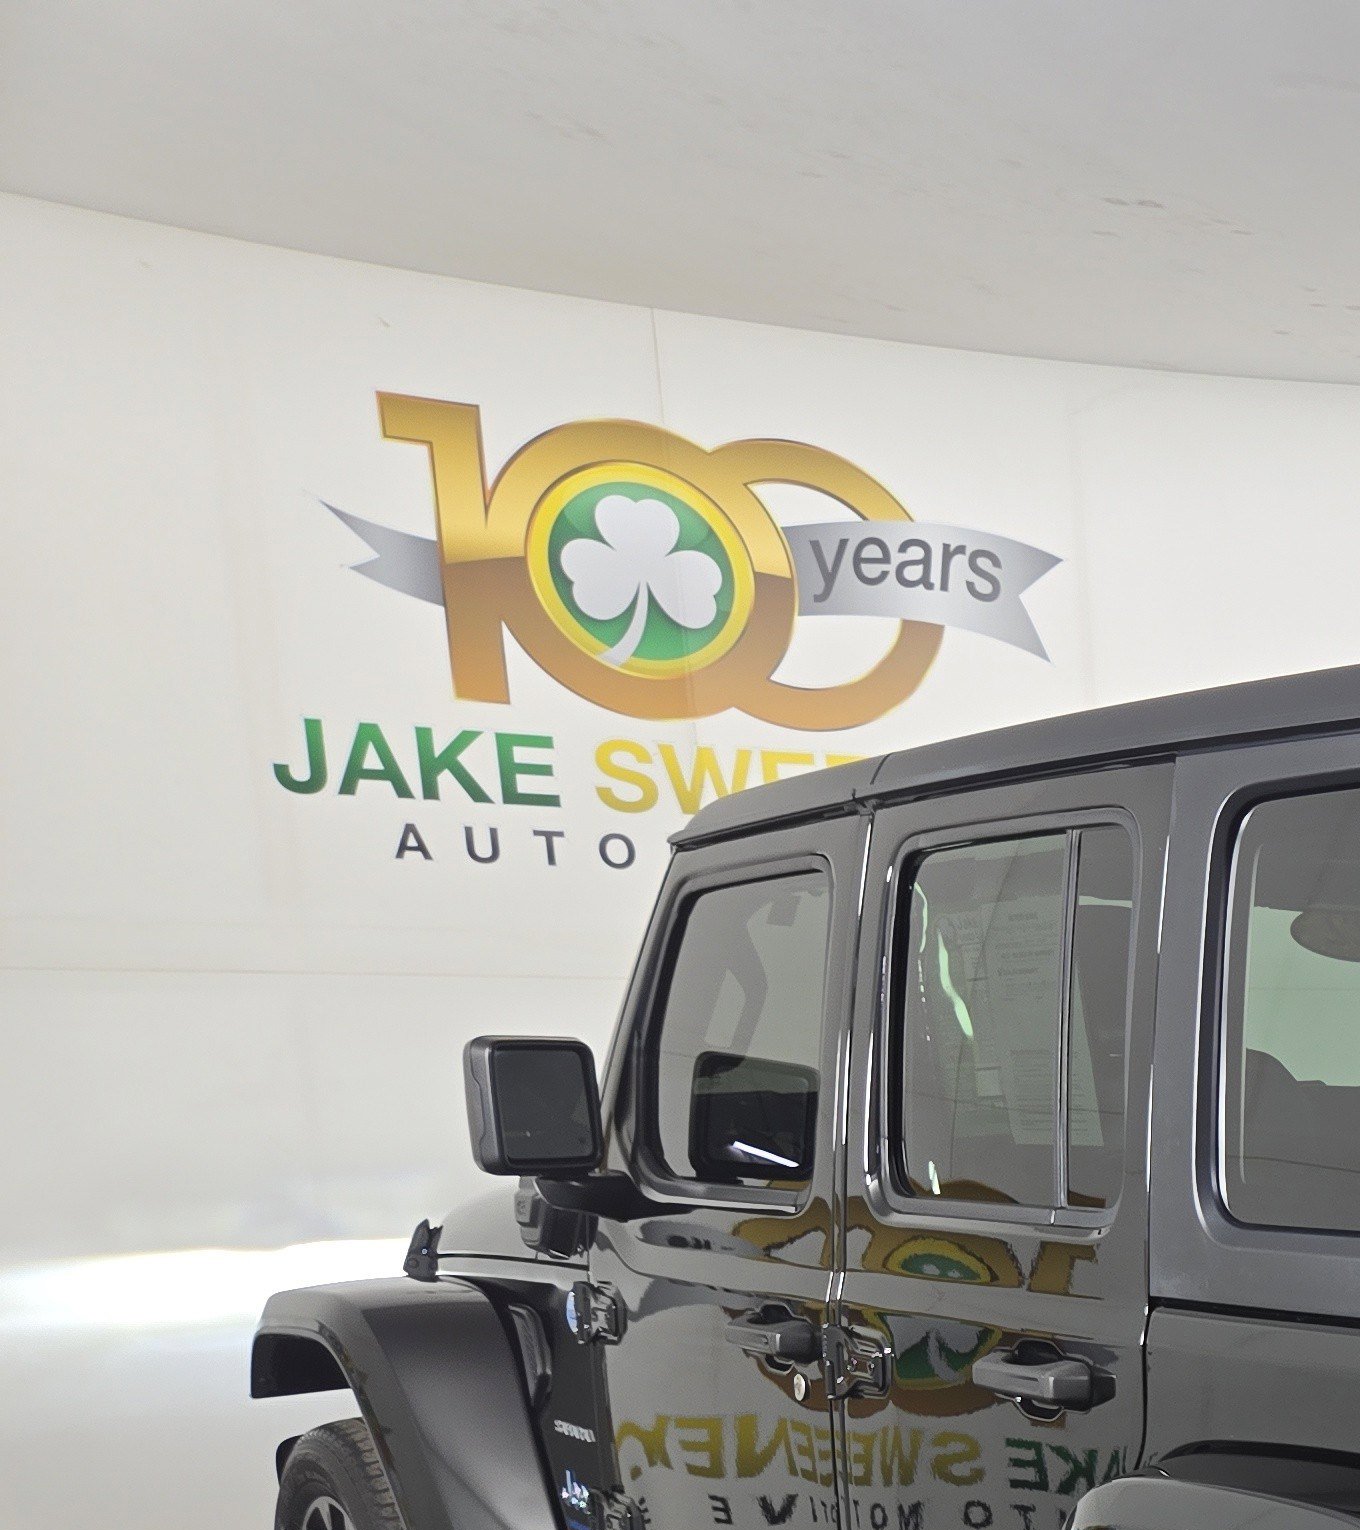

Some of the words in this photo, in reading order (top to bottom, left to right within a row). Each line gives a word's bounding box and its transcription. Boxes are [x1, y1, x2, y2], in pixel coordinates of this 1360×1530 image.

[375, 390, 946, 732] 100
[808, 534, 1004, 606] years
[272, 716, 563, 810] JAKE
